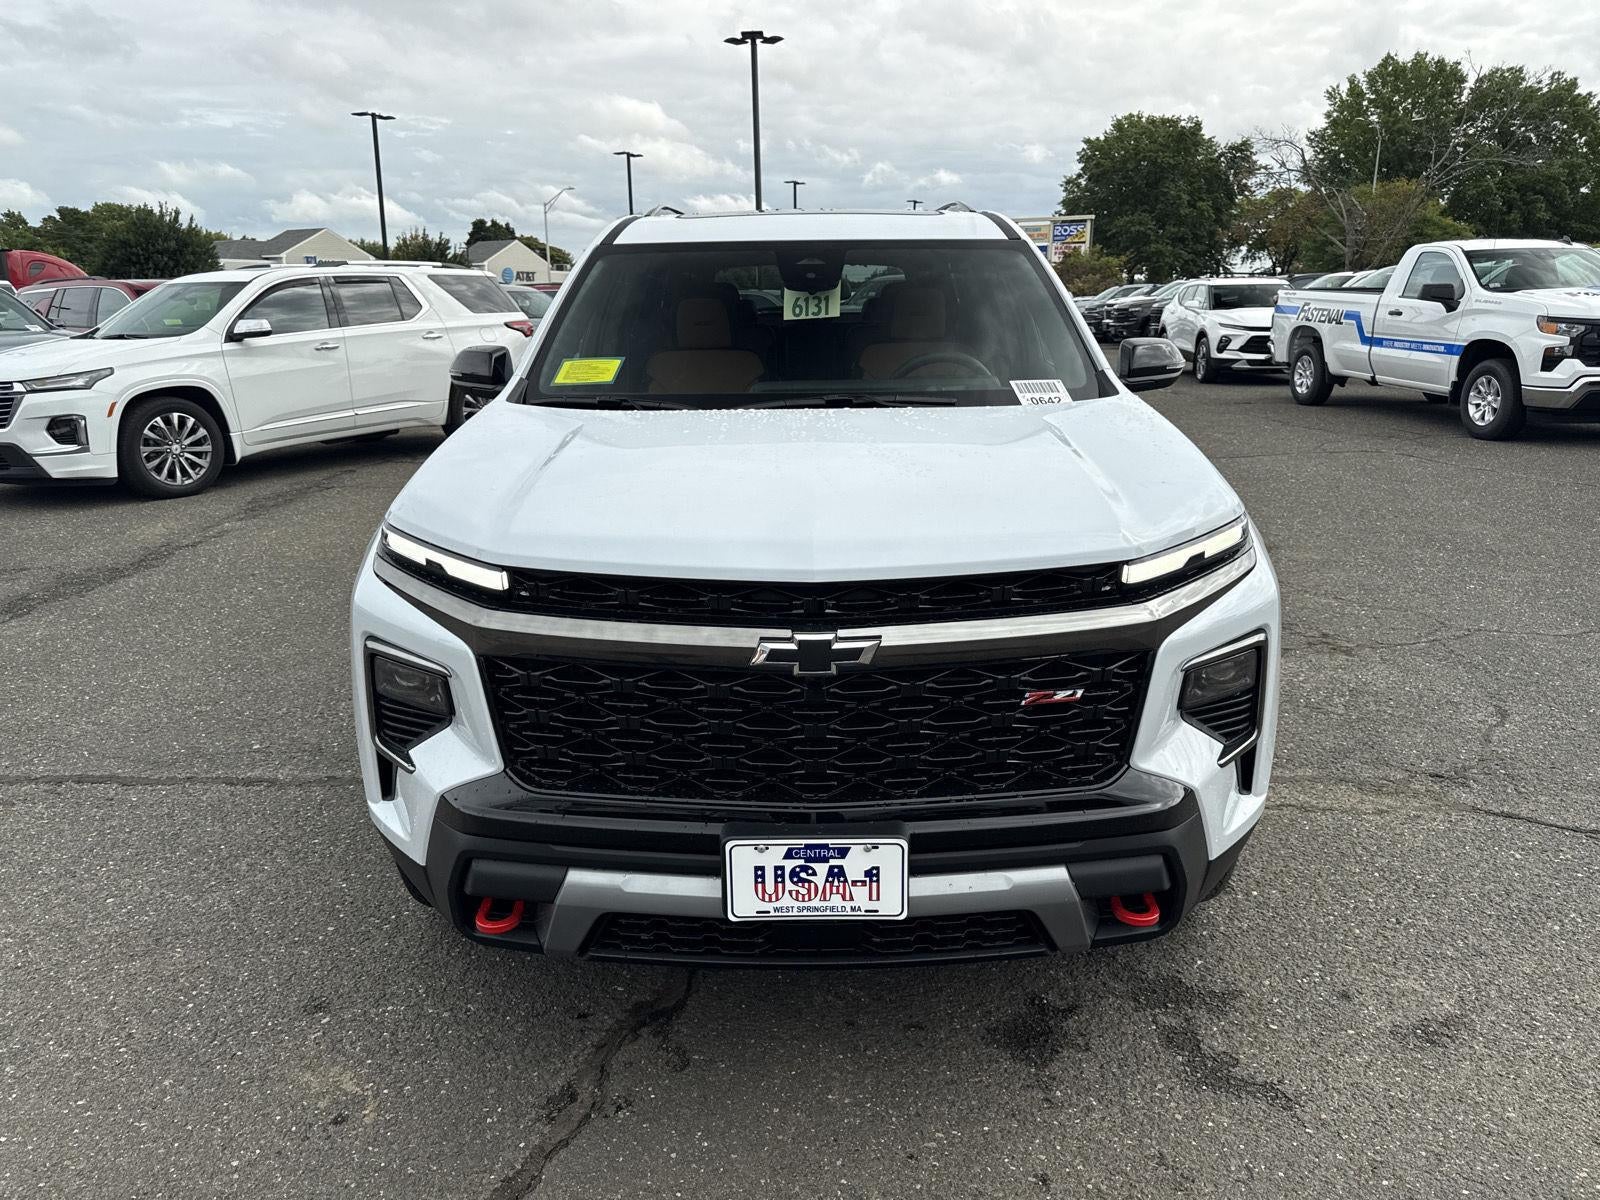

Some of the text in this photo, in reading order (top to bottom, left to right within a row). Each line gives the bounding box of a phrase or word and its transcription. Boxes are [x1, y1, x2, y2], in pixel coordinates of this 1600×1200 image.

[1054, 225, 1084, 235] ROSS
[515, 271, 536, 282] AT&T
[792, 295, 830, 318] 6131
[1296, 302, 1345, 325] FASTENAL
[792, 849, 841, 858] CENTRAL
[753, 864, 881, 903] USA-1
[796, 905, 849, 914] SPRINGFIELD,
[850, 905, 862, 913] MA
